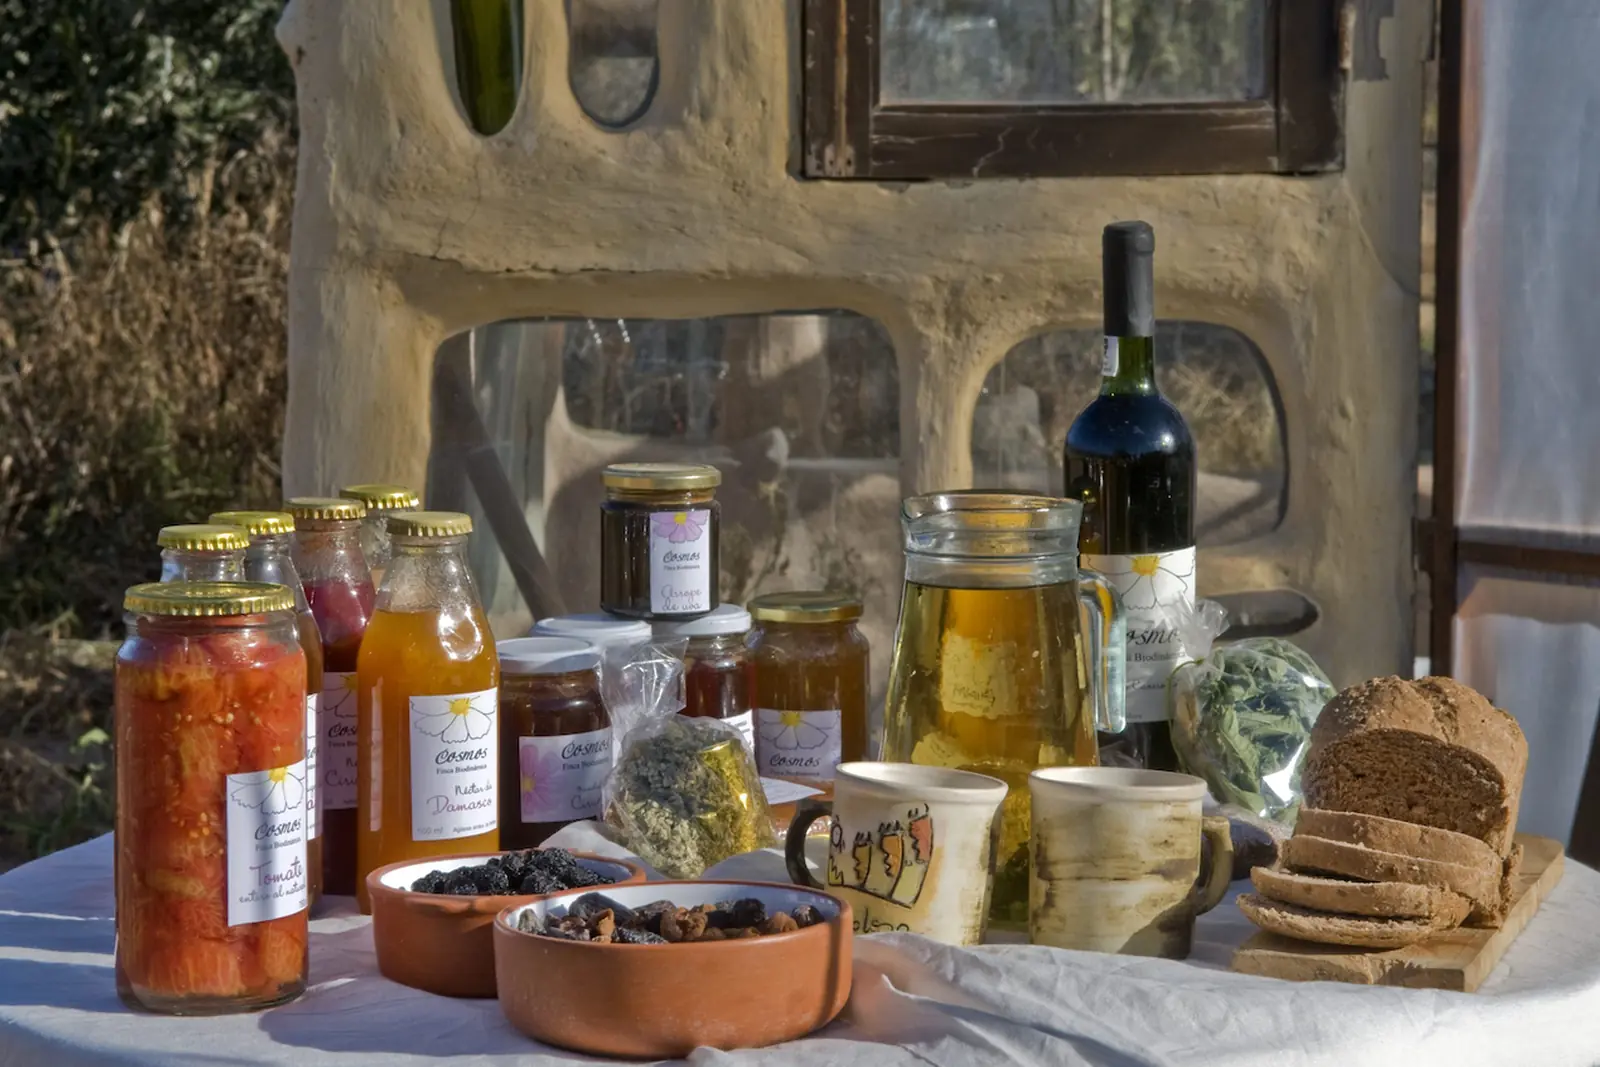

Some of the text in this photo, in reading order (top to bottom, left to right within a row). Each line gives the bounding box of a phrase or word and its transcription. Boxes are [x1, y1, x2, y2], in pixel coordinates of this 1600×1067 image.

[663, 550, 701, 563] Cosmos
[328, 723, 358, 738] Cos
[435, 748, 488, 765] Cosmos
[561, 740, 609, 760] Cosmos
[770, 754, 821, 768] Cosmos
[426, 795, 492, 816] Damasco
[254, 818, 301, 841] Cosmos
